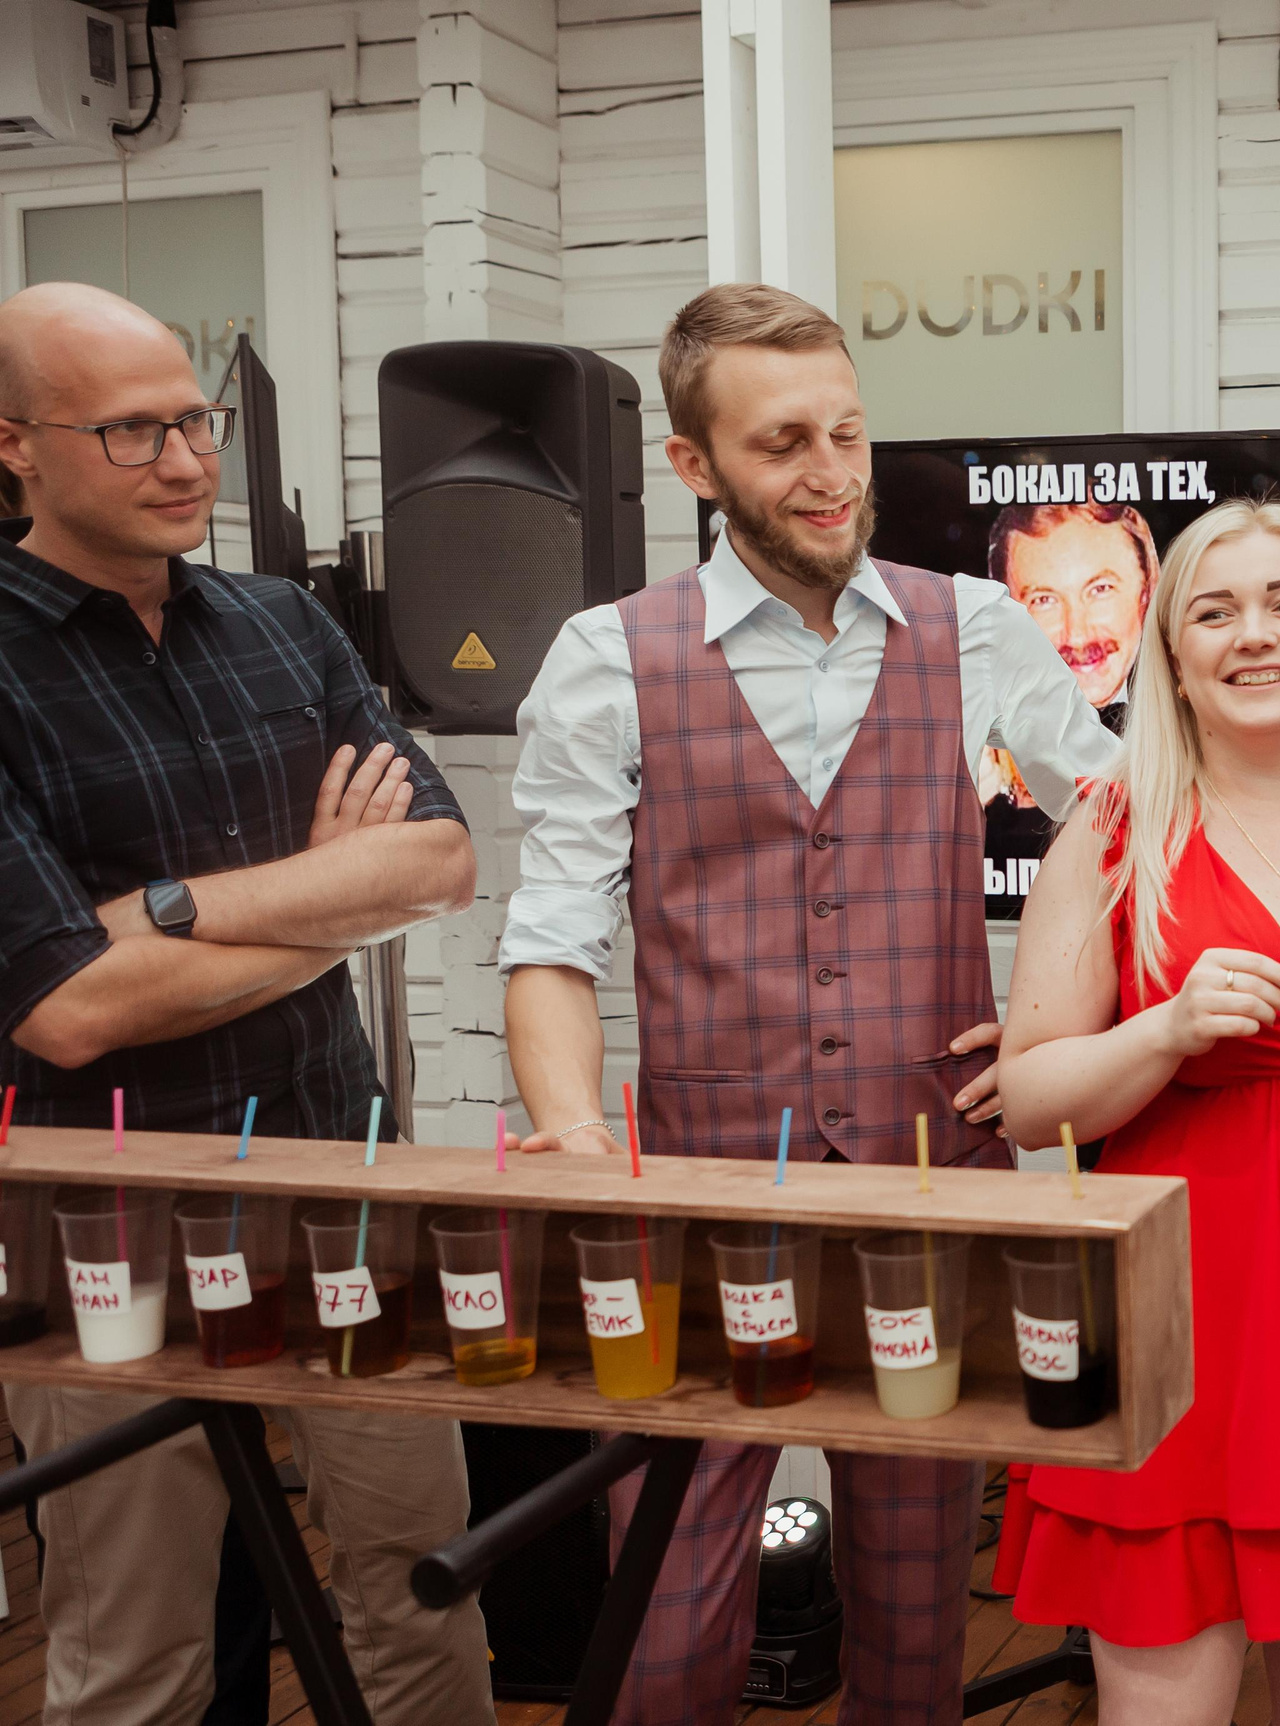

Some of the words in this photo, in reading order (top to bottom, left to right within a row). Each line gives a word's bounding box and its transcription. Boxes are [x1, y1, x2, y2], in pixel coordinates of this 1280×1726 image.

[862, 269, 1105, 340] DUDKI
[969, 463, 1085, 504] БОКАЛ
[1094, 463, 1141, 502] ЗА
[1147, 461, 1216, 504] ТЕХ,
